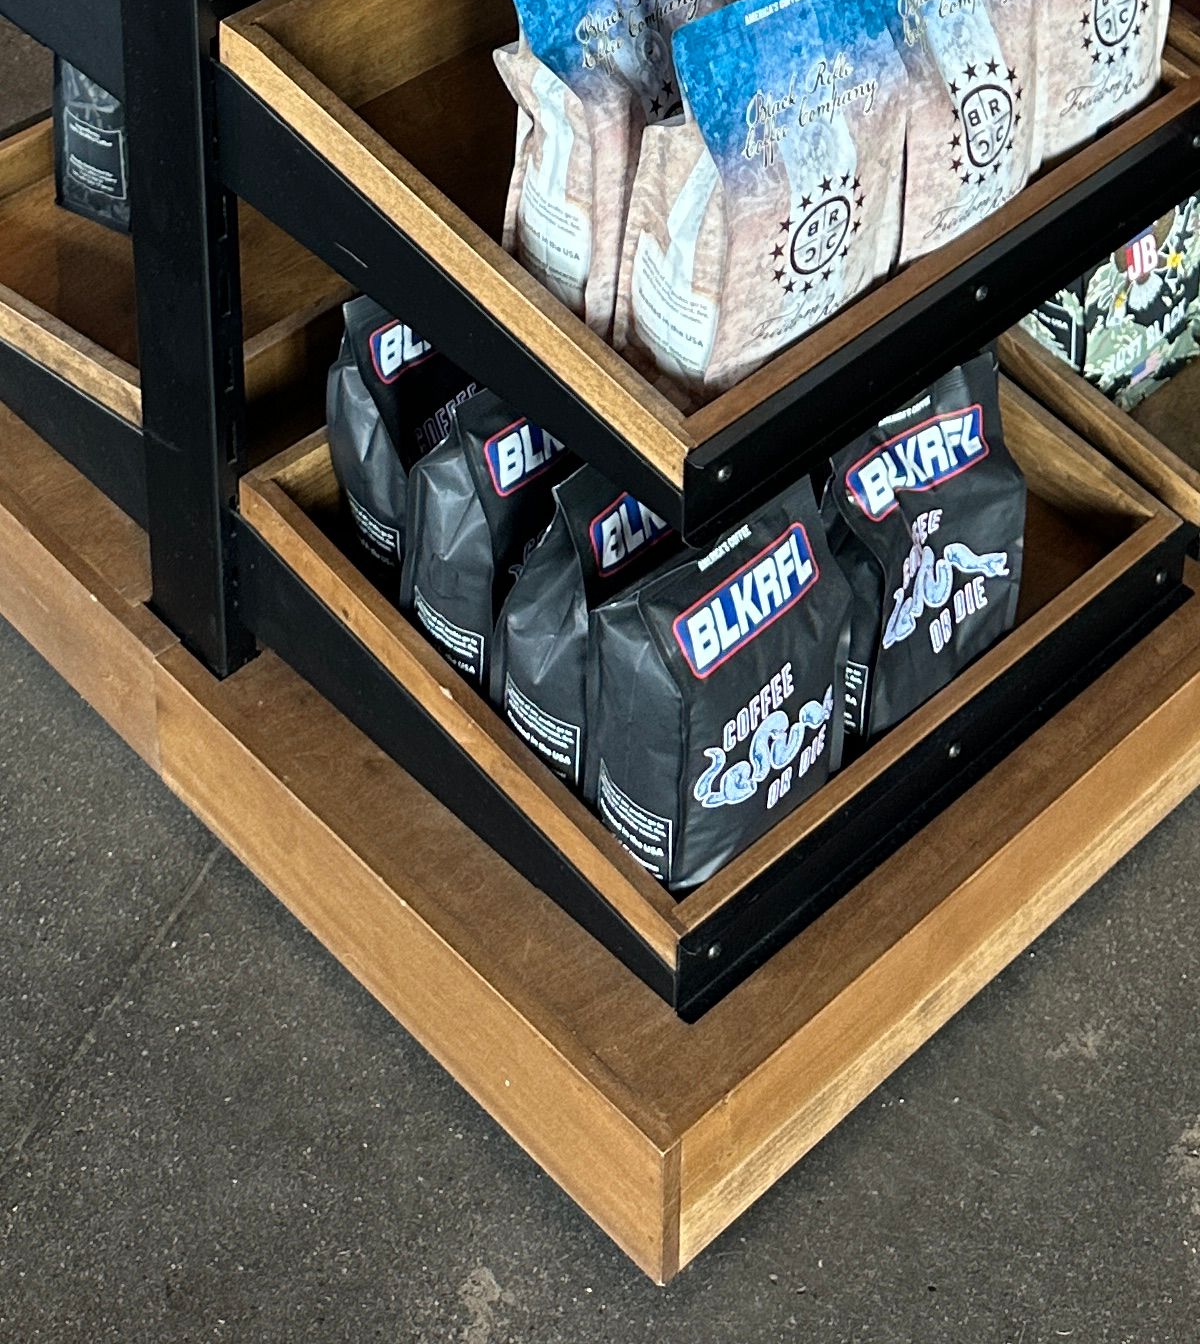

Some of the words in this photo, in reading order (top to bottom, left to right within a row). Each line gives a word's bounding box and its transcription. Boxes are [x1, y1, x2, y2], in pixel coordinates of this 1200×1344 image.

[575, 8, 624, 45] Black
[741, 117, 788, 168] Coffee
[798, 77, 878, 129] Company
[746, 74, 797, 127] Black
[808, 52, 854, 100] Rifle
[1127, 234, 1158, 281] JB
[685, 332, 704, 348] USA
[859, 414, 982, 514] BLKRFL
[698, 539, 731, 572] AMERICA'S
[730, 524, 752, 552] COFFEE
[687, 534, 813, 670] BLKRFL
[930, 608, 952, 654] OR
[954, 577, 988, 624] DIE
[724, 662, 794, 752] COFFEE
[552, 748, 571, 766] USA
[767, 767, 792, 809] OR
[799, 724, 826, 778] DIE
[643, 840, 663, 858] USA
